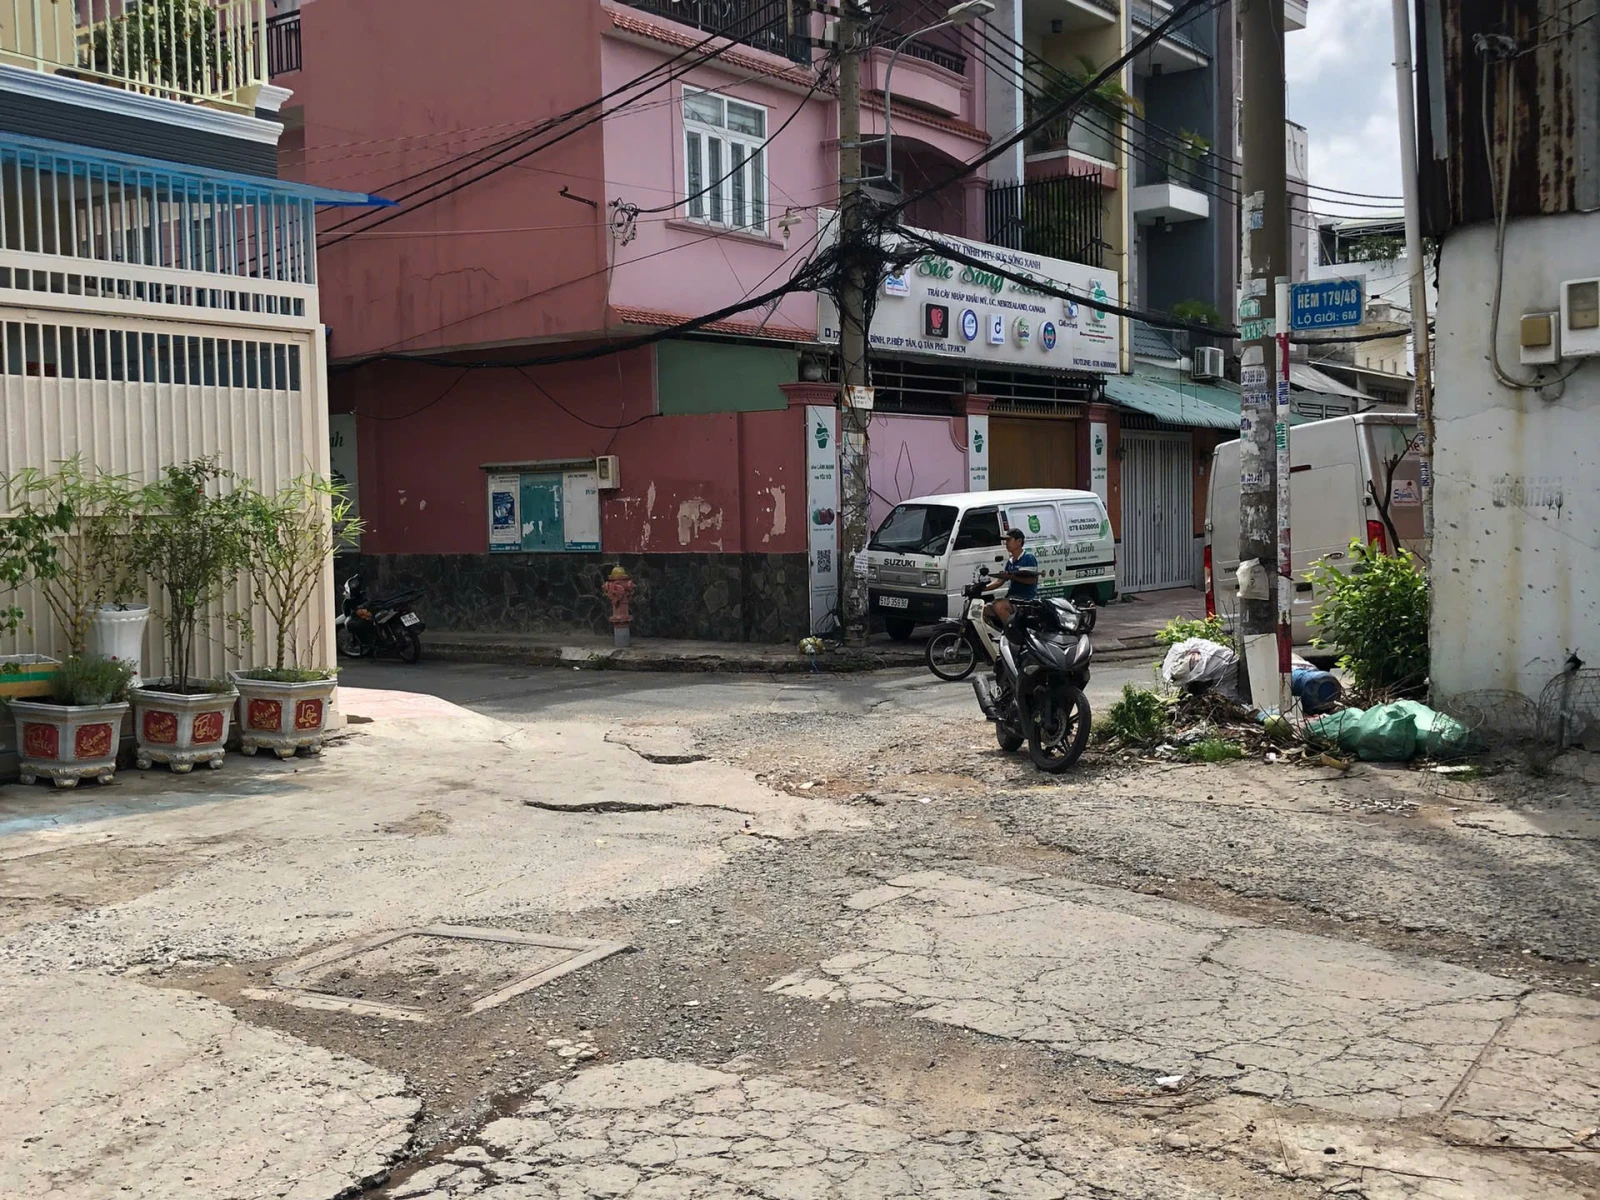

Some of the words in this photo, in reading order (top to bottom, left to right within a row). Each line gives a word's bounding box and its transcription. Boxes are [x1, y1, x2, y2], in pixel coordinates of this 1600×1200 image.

[963, 245, 980, 257] TNHH
[1025, 259, 1041, 270] XANH
[1297, 289, 1320, 309] HẺM
[1323, 288, 1357, 307] 179/48
[1029, 304, 1046, 314] CANADA
[1297, 313, 1312, 326] LỘ
[1314, 310, 1339, 324] GIỚI:
[1342, 310, 1357, 321] 6M
[1080, 523, 1100, 531] 6300000
[884, 558, 916, 568] SUZUKI
